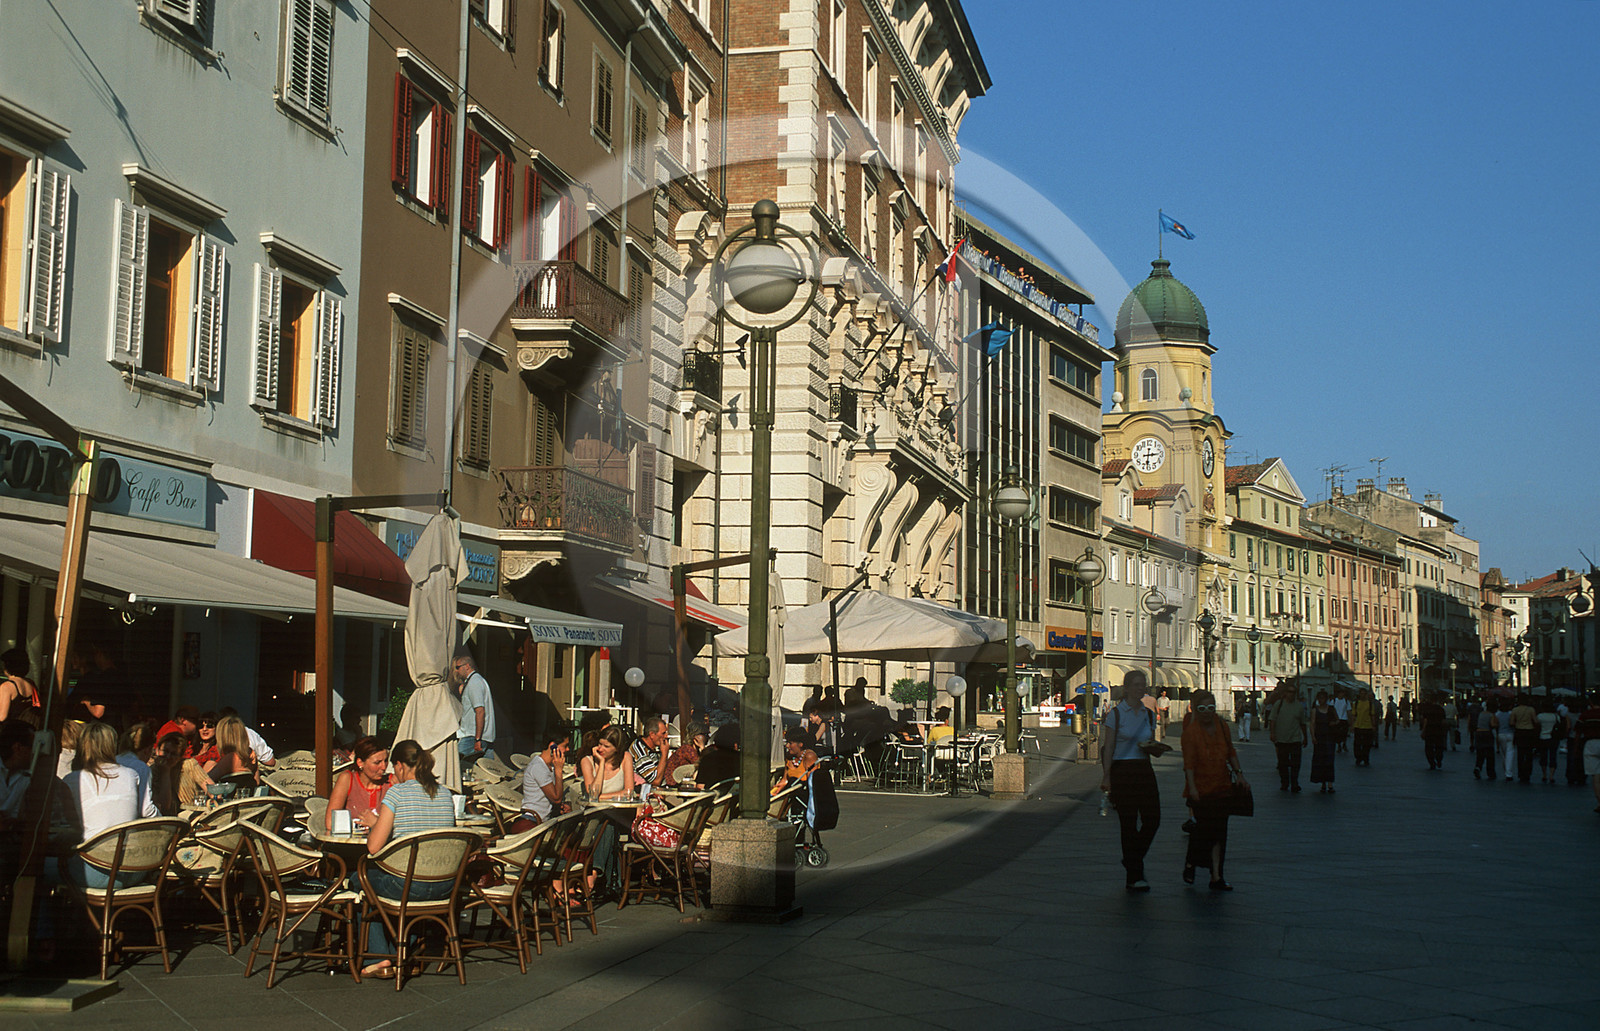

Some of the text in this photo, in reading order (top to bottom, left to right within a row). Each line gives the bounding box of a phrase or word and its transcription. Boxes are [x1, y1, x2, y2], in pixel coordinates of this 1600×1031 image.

[126, 468, 197, 512] Caffe Bar
[465, 548, 496, 566] Panasonic
[467, 565, 495, 584] SONY
[532, 625, 621, 642] SONY Panasonic SONY
